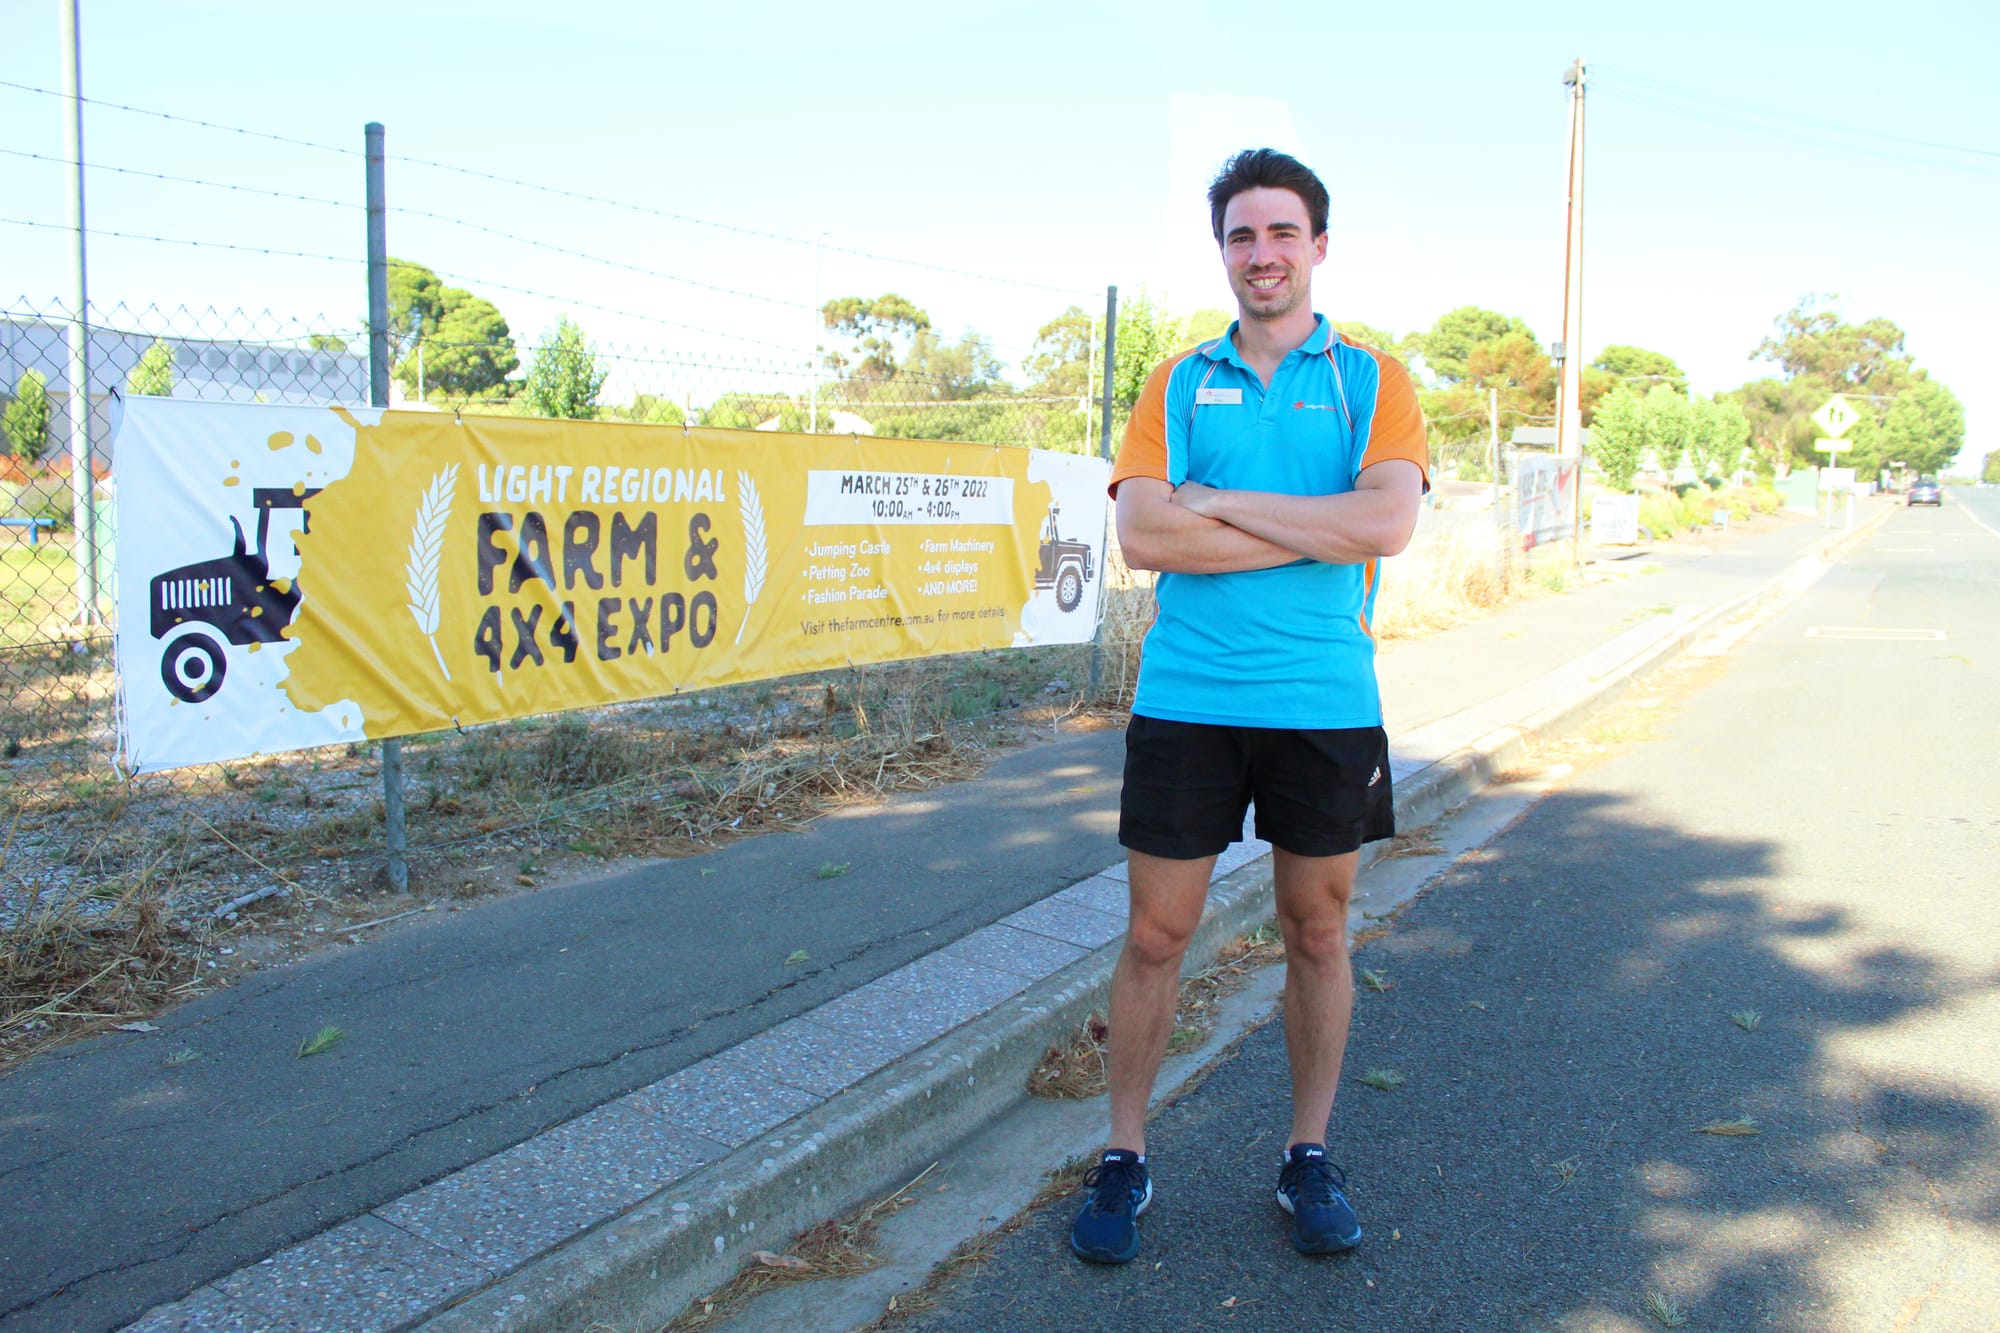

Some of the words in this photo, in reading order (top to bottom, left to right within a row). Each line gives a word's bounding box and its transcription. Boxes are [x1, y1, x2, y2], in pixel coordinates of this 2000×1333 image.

[478, 463, 573, 503] LIGHT
[581, 465, 726, 504] REGIONAL
[840, 475, 891, 495] MARCH
[895, 476, 919, 496] 25TH
[921, 478, 930, 496] &
[934, 478, 960, 497] 26TH
[961, 479, 989, 498] 2022
[872, 500, 913, 520] 10:00AM
[926, 500, 960, 520] 4:00PM
[477, 510, 658, 596] FARM
[684, 512, 719, 582] &
[808, 540, 857, 559] Jumping
[924, 539, 948, 553] Farm
[950, 538, 995, 555] Machinery
[808, 563, 847, 582] Petting
[849, 562, 871, 578] Zoo
[923, 560, 942, 574] 4x4
[944, 559, 979, 576] displays
[807, 587, 847, 605] Fashion
[849, 584, 888, 600] Parade
[923, 580, 945, 596] AND
[946, 578, 978, 595] MORE!
[801, 619, 825, 636] Visit
[828, 614, 935, 633] thefarmcentre.com.au
[937, 609, 950, 622] for
[952, 609, 976, 620] more
[978, 605, 1005, 619] details
[474, 600, 579, 673] 4X4
[597, 590, 718, 661] EXPO
